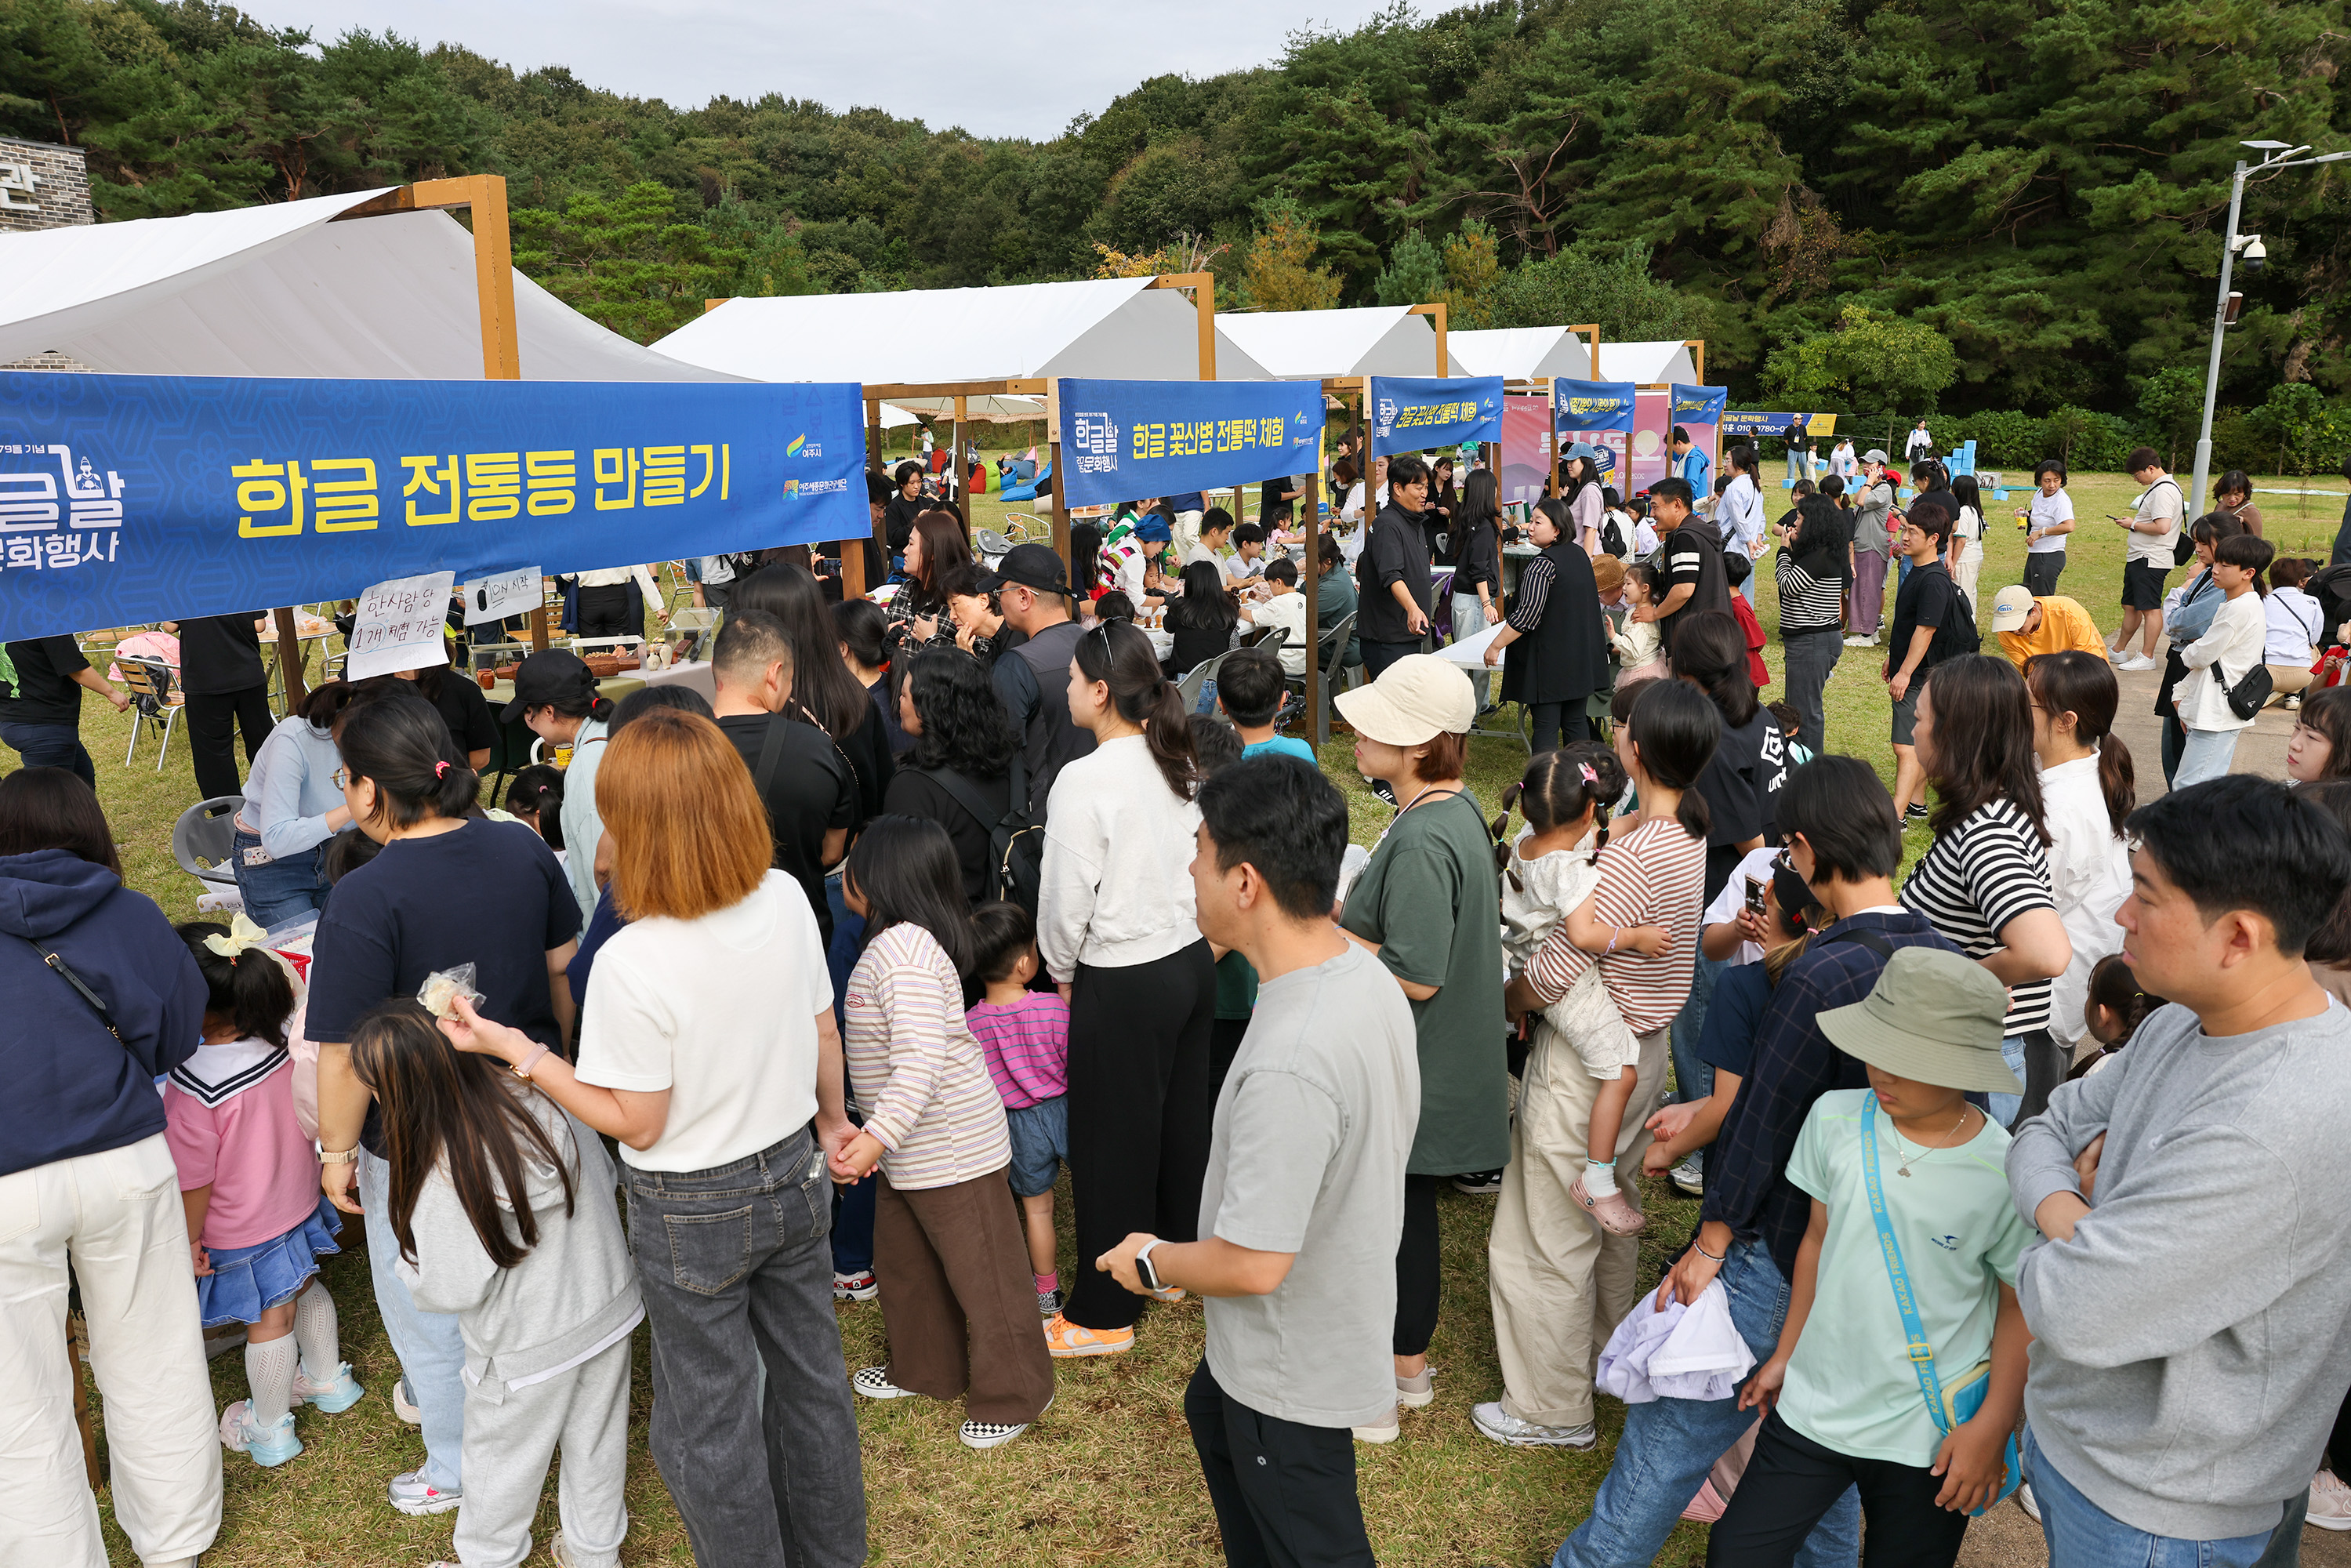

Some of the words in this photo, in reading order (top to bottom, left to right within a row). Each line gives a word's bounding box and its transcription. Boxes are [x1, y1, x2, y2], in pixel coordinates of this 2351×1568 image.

[1075, 412, 1119, 454] 한글날
[1395, 405, 1419, 429] 한글
[1459, 401, 1477, 423] 체험
[25, 445, 45, 454] 기념
[802, 448, 822, 458] 여주시
[1133, 423, 1166, 459] 한글
[1170, 420, 1213, 457] 꽃산병
[1217, 419, 1257, 453] 전통떡
[1258, 416, 1285, 447] 체험
[1084, 455, 1118, 473] 문화행사
[231, 458, 380, 539] 한글
[400, 450, 576, 527] 전통등
[593, 443, 731, 511] 만들기
[0, 531, 120, 572] 화행사
[511, 575, 529, 593] 시작
[388, 622, 410, 641] 체험
[416, 615, 440, 638] 가능
[1864, 1131, 1876, 1174] FRIENDS
[1868, 1176, 1883, 1214] KAKAO
[1881, 1232, 1902, 1276] FRIENDS
[1895, 1277, 1914, 1316] KAKAO
[1922, 1377, 1940, 1414] KAKAO
